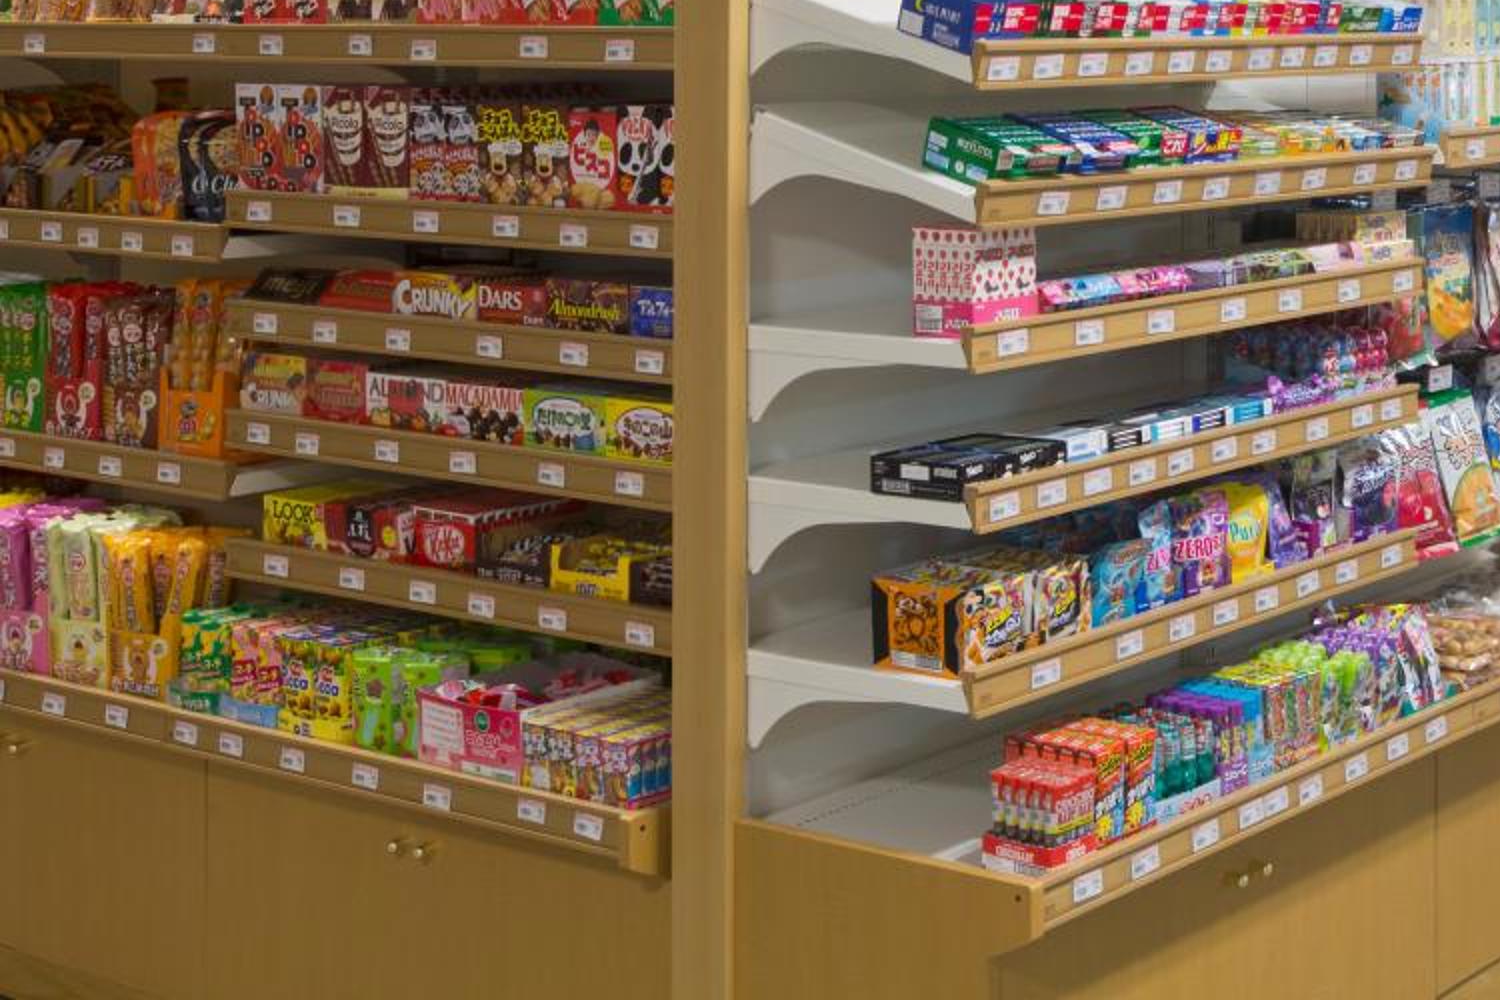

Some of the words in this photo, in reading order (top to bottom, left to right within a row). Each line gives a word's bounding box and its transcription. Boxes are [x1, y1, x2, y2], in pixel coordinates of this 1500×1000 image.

[392, 278, 472, 320] CRUNKY
[478, 285, 523, 311] DARS
[272, 500, 314, 524] LOOK
